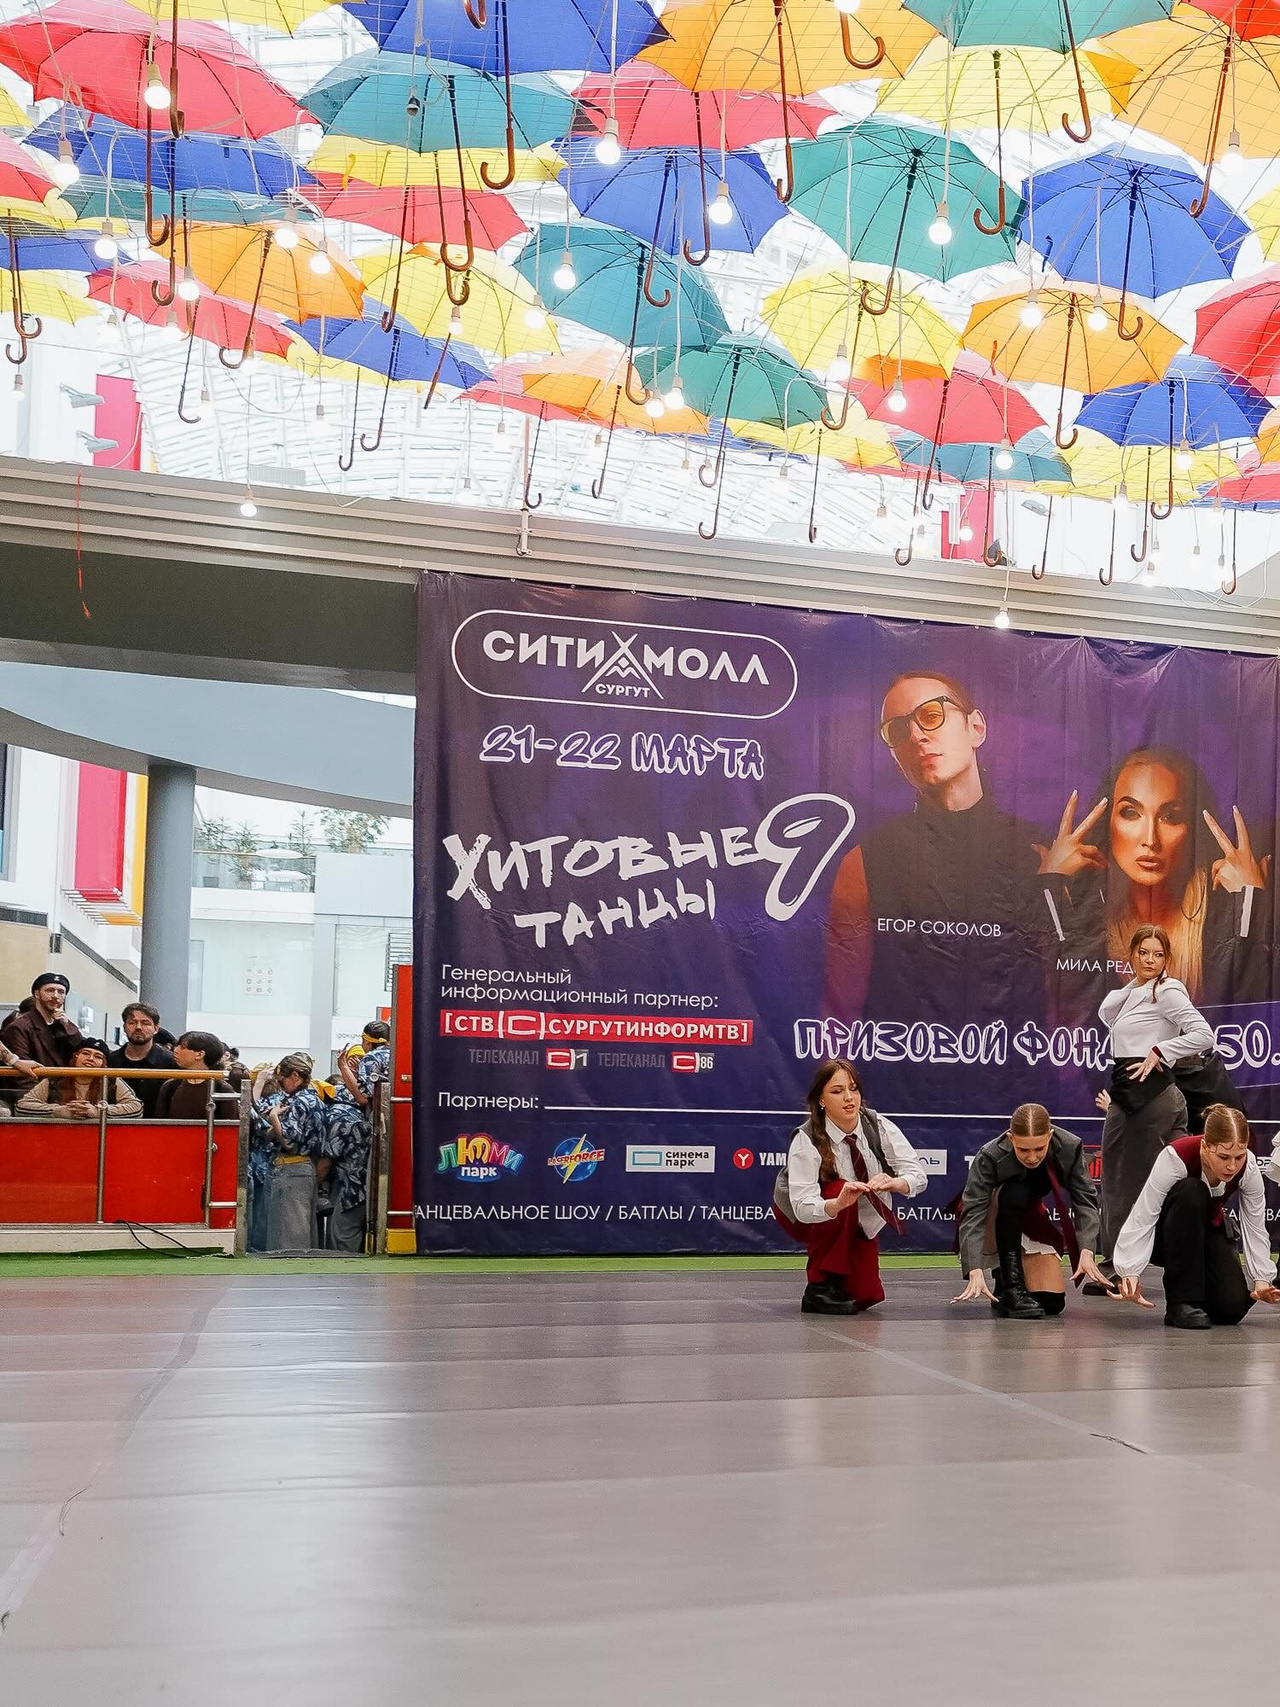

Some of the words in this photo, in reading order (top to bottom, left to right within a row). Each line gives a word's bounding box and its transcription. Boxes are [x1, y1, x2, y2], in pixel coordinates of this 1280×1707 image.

[483, 630, 604, 669] СИТИ
[643, 643, 770, 686] МОЛЛ
[595, 682, 651, 698] СУРГУТ
[480, 724, 621, 770] 21-22
[631, 732, 764, 781] МАРТА
[442, 826, 760, 910] ХИТОВЫЕ
[514, 878, 716, 949] ТАНЦЫ
[877, 917, 916, 933] ЕГОР
[920, 919, 1002, 937] СОКОЛОВ
[441, 963, 572, 985] Генеральный
[1056, 958, 1102, 973] МИЛА
[1107, 959, 1136, 975] РЕД
[441, 983, 628, 1005] информационный
[634, 991, 719, 1011] партнер:
[793, 1017, 1008, 1065] ПРИЗОВОЙ
[469, 1048, 540, 1065] ТЕЛЕКАНАЛ
[598, 1052, 666, 1068] ТЕЛЕКАНАЛ
[438, 1091, 539, 1111] Партнеры:
[665, 1151, 710, 1160] синема
[665, 1159, 696, 1169] парк
[758, 1152, 787, 1166] YAM
[461, 1165, 498, 1180] парк
[555, 1205, 600, 1220] ШОУ
[619, 1205, 683, 1220] БАТТЛЫ
[700, 1205, 777, 1222] ТАНЦЕВА
